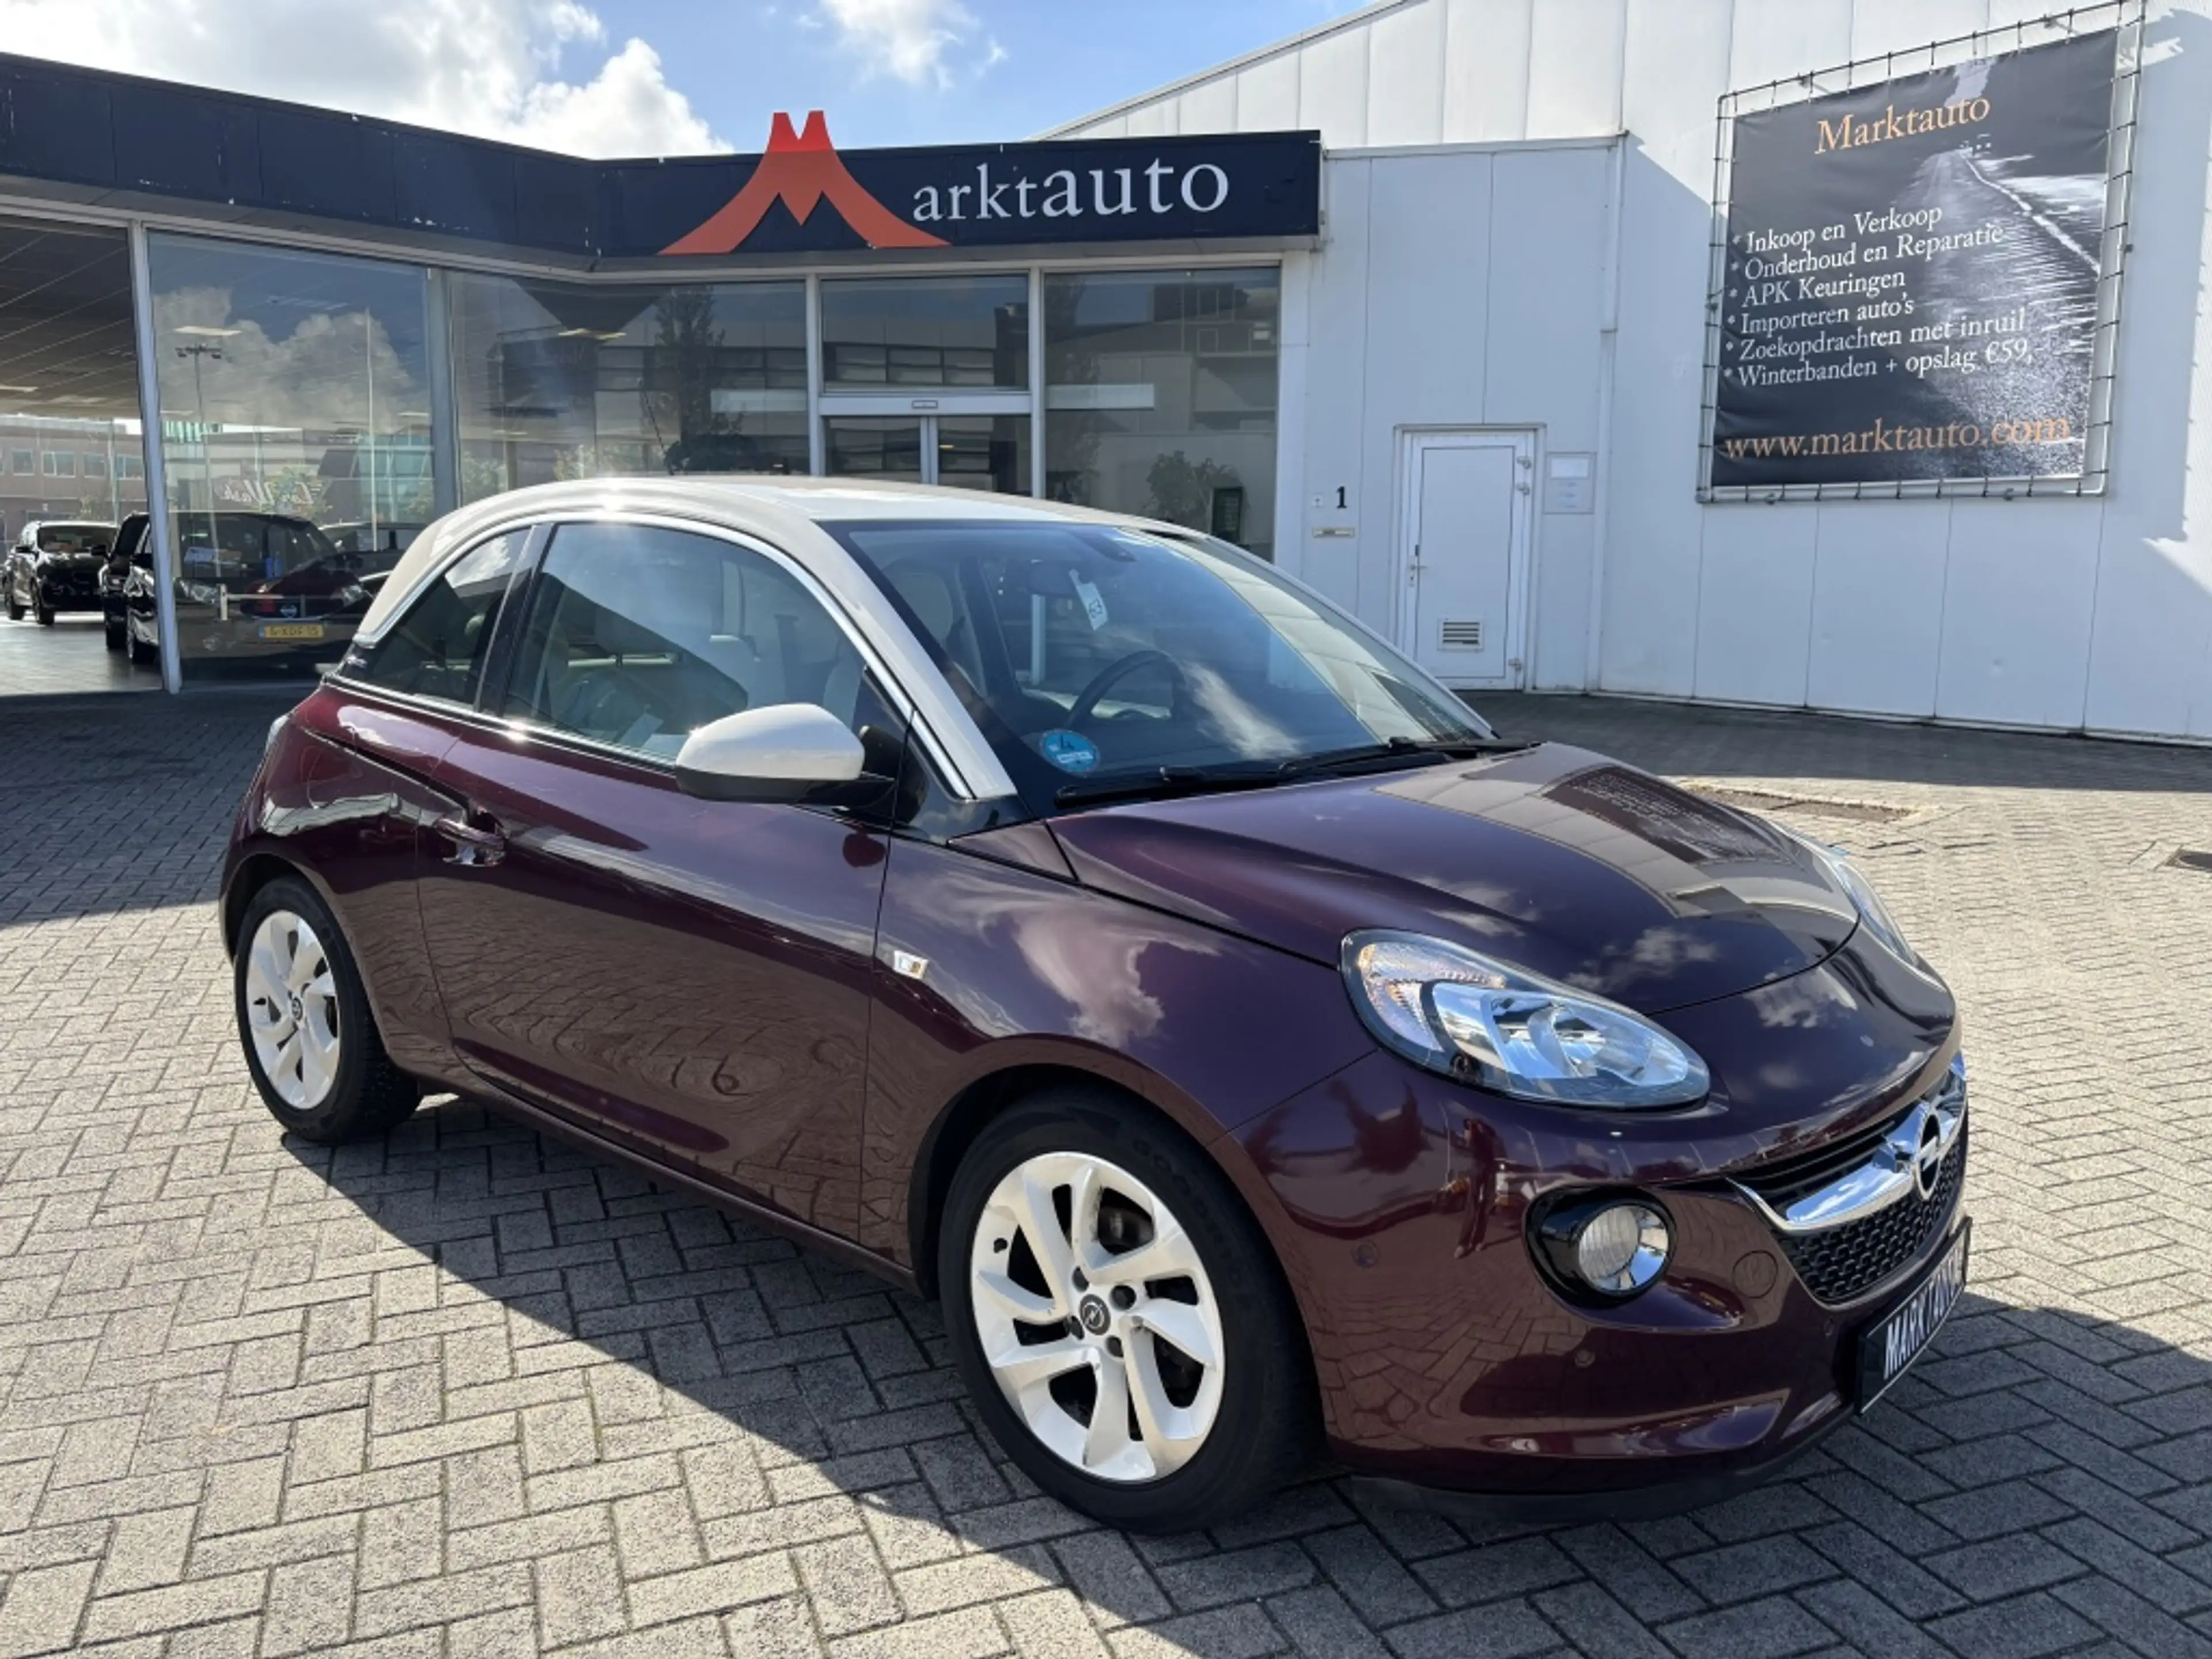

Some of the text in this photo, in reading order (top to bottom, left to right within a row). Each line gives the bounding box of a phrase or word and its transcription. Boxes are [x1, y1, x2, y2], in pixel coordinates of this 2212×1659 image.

[1815, 98, 1991, 154] Marktauto
[1745, 207, 1943, 253] Inkoop en Verkoop
[1745, 222, 2004, 280] Onderhoud en Reparatie
[1741, 271, 1906, 308] APK Keuringen
[1739, 306, 2025, 362] Zoekopdrachten met inruil
[1741, 291, 1915, 338] Importeren auto's
[1738, 355, 1878, 387] Winterbanden
[1885, 358, 1897, 372] +
[1905, 346, 1977, 379] opslag
[1724, 417, 2071, 460] www.marktauto.com
[1336, 486, 1348, 509] 1
